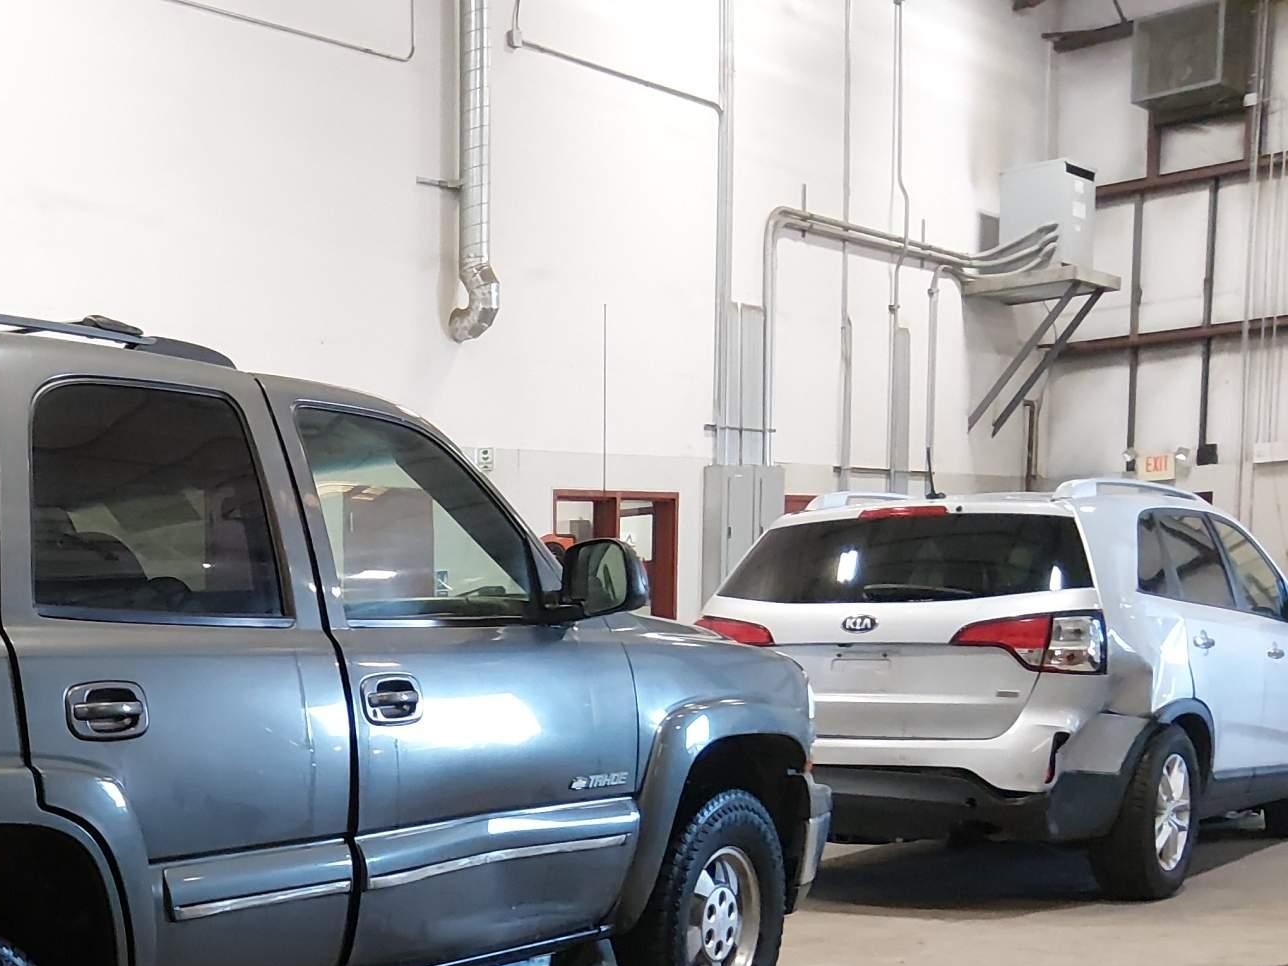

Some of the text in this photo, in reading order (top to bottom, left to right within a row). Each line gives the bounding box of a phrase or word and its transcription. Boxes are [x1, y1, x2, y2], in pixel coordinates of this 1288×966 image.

[1145, 455, 1168, 473] EXIT
[845, 617, 872, 630] KIA
[588, 772, 629, 788] TAHOE
